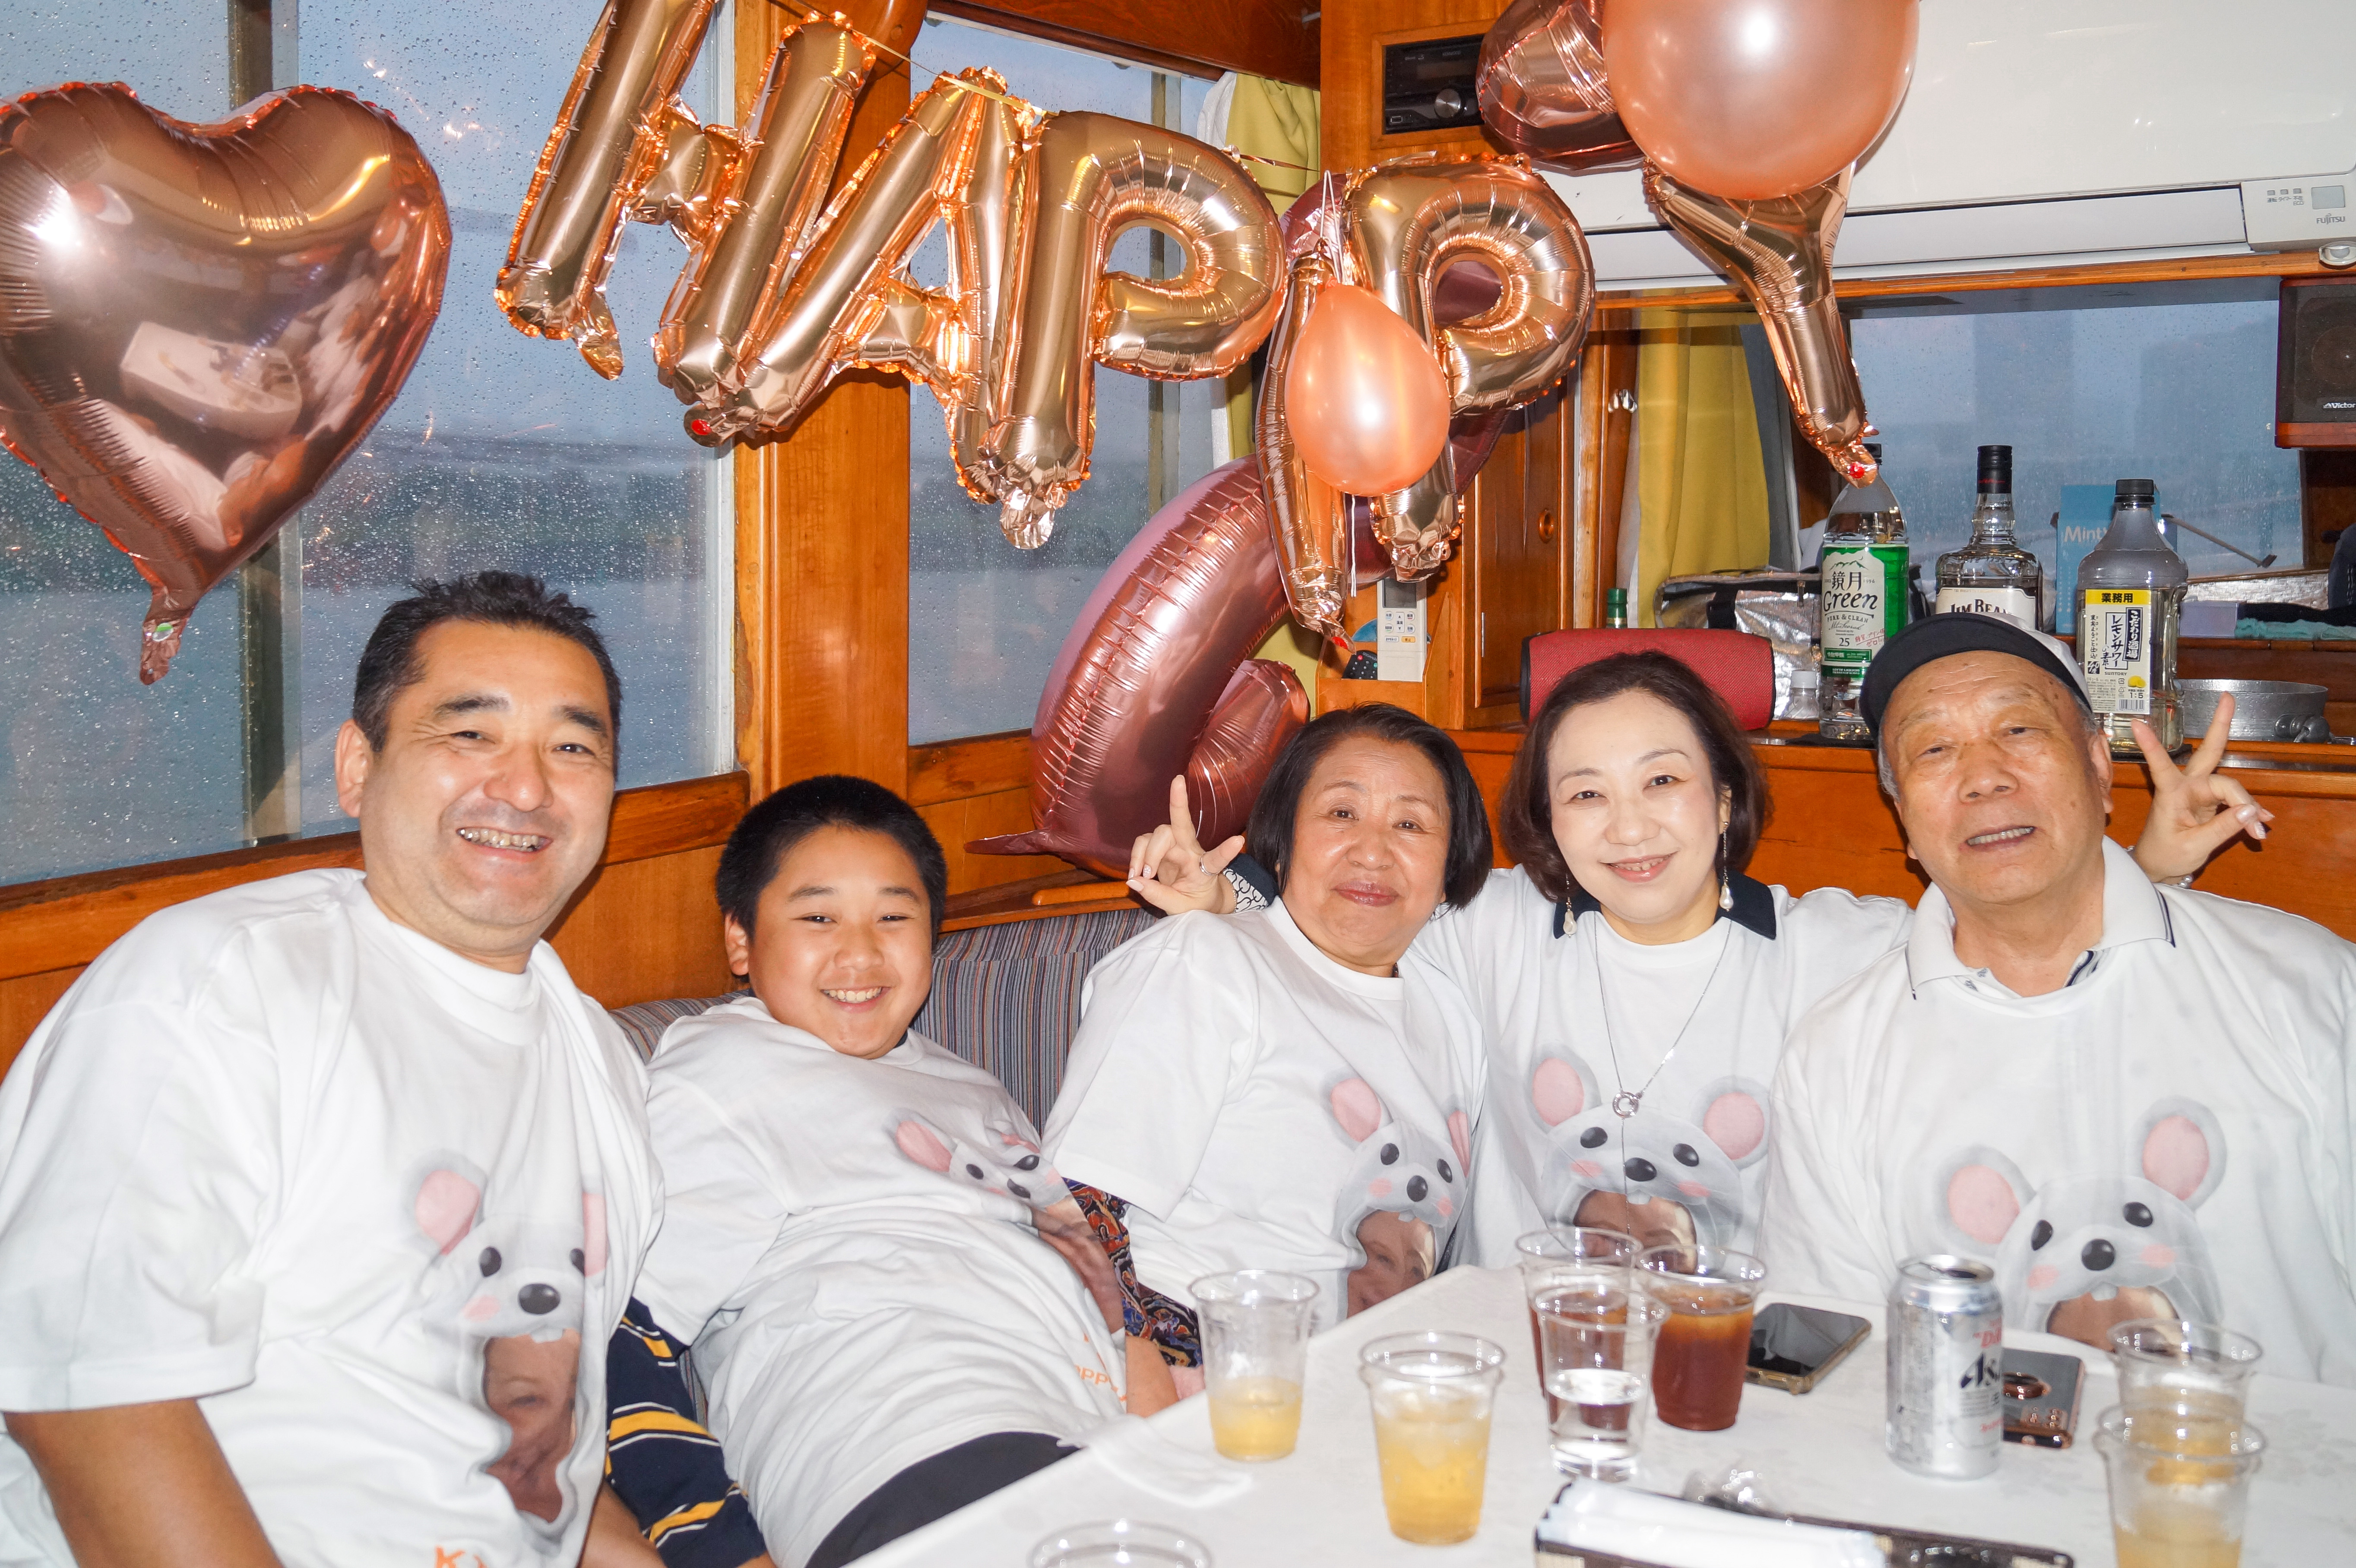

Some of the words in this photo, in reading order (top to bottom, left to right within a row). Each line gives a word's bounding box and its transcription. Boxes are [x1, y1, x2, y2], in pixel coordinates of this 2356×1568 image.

[2316, 213, 2345, 224] FUJITSU
[2064, 525, 2108, 542] Mint
[1831, 571, 1862, 591] 鏡月
[1823, 591, 1878, 612] Green
[2101, 593, 2133, 603] 業務用
[1975, 599, 2010, 614] BEA
[1848, 615, 1869, 623] CLEAN
[2126, 610, 2140, 658] こだわり酒場
[1839, 638, 1850, 647] 25
